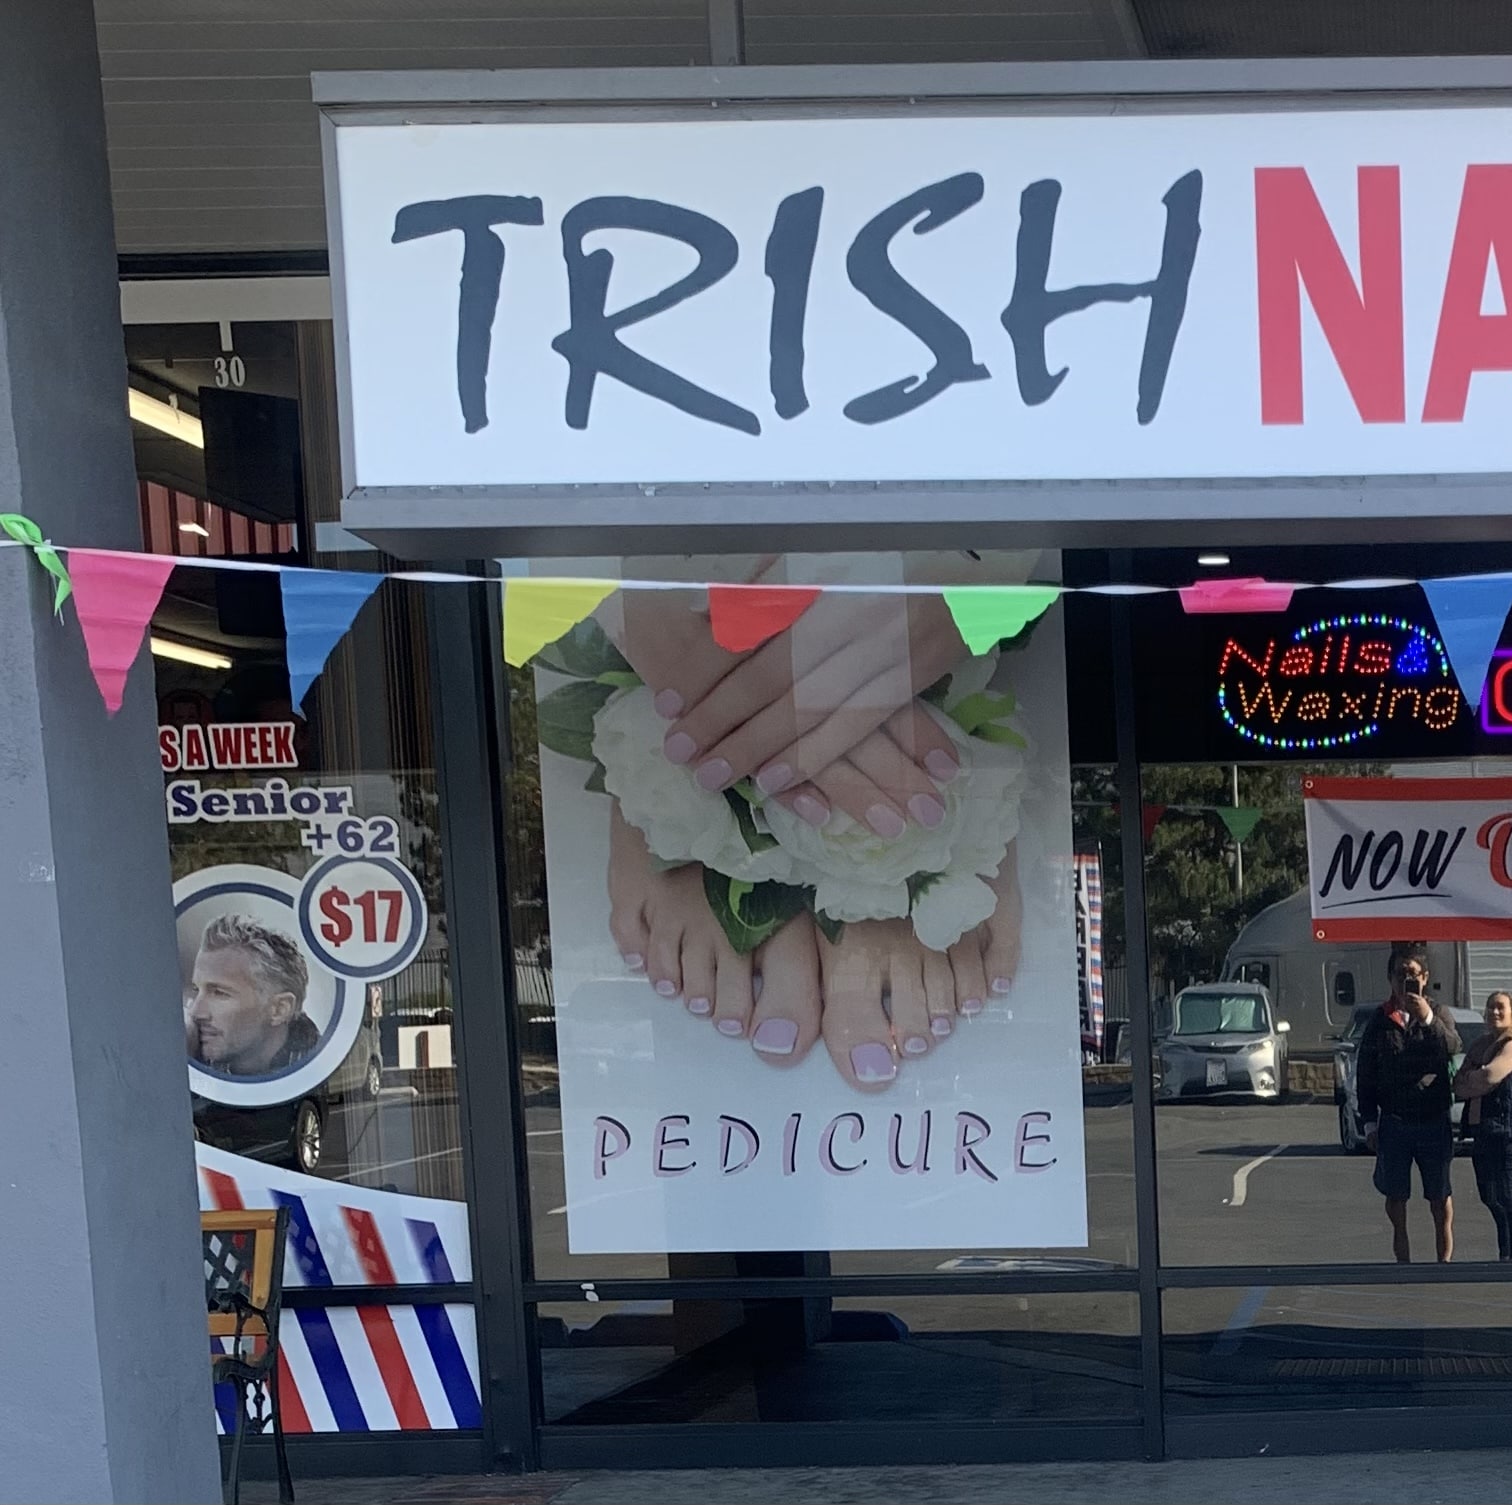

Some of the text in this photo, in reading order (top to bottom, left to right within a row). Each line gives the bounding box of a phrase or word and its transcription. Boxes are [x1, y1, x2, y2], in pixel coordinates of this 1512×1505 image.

[391, 168, 1202, 435] TRISH
[214, 355, 246, 388] 30
[1218, 633, 1392, 677] Nails
[1236, 681, 1460, 730] Waxing
[186, 729, 205, 766] A
[211, 726, 294, 765] WEEK
[170, 782, 348, 817] Senior
[306, 820, 395, 852] +62
[1319, 826, 1467, 898] NOW
[318, 886, 403, 948] $17
[593, 1110, 1058, 1183] PEDICURE
